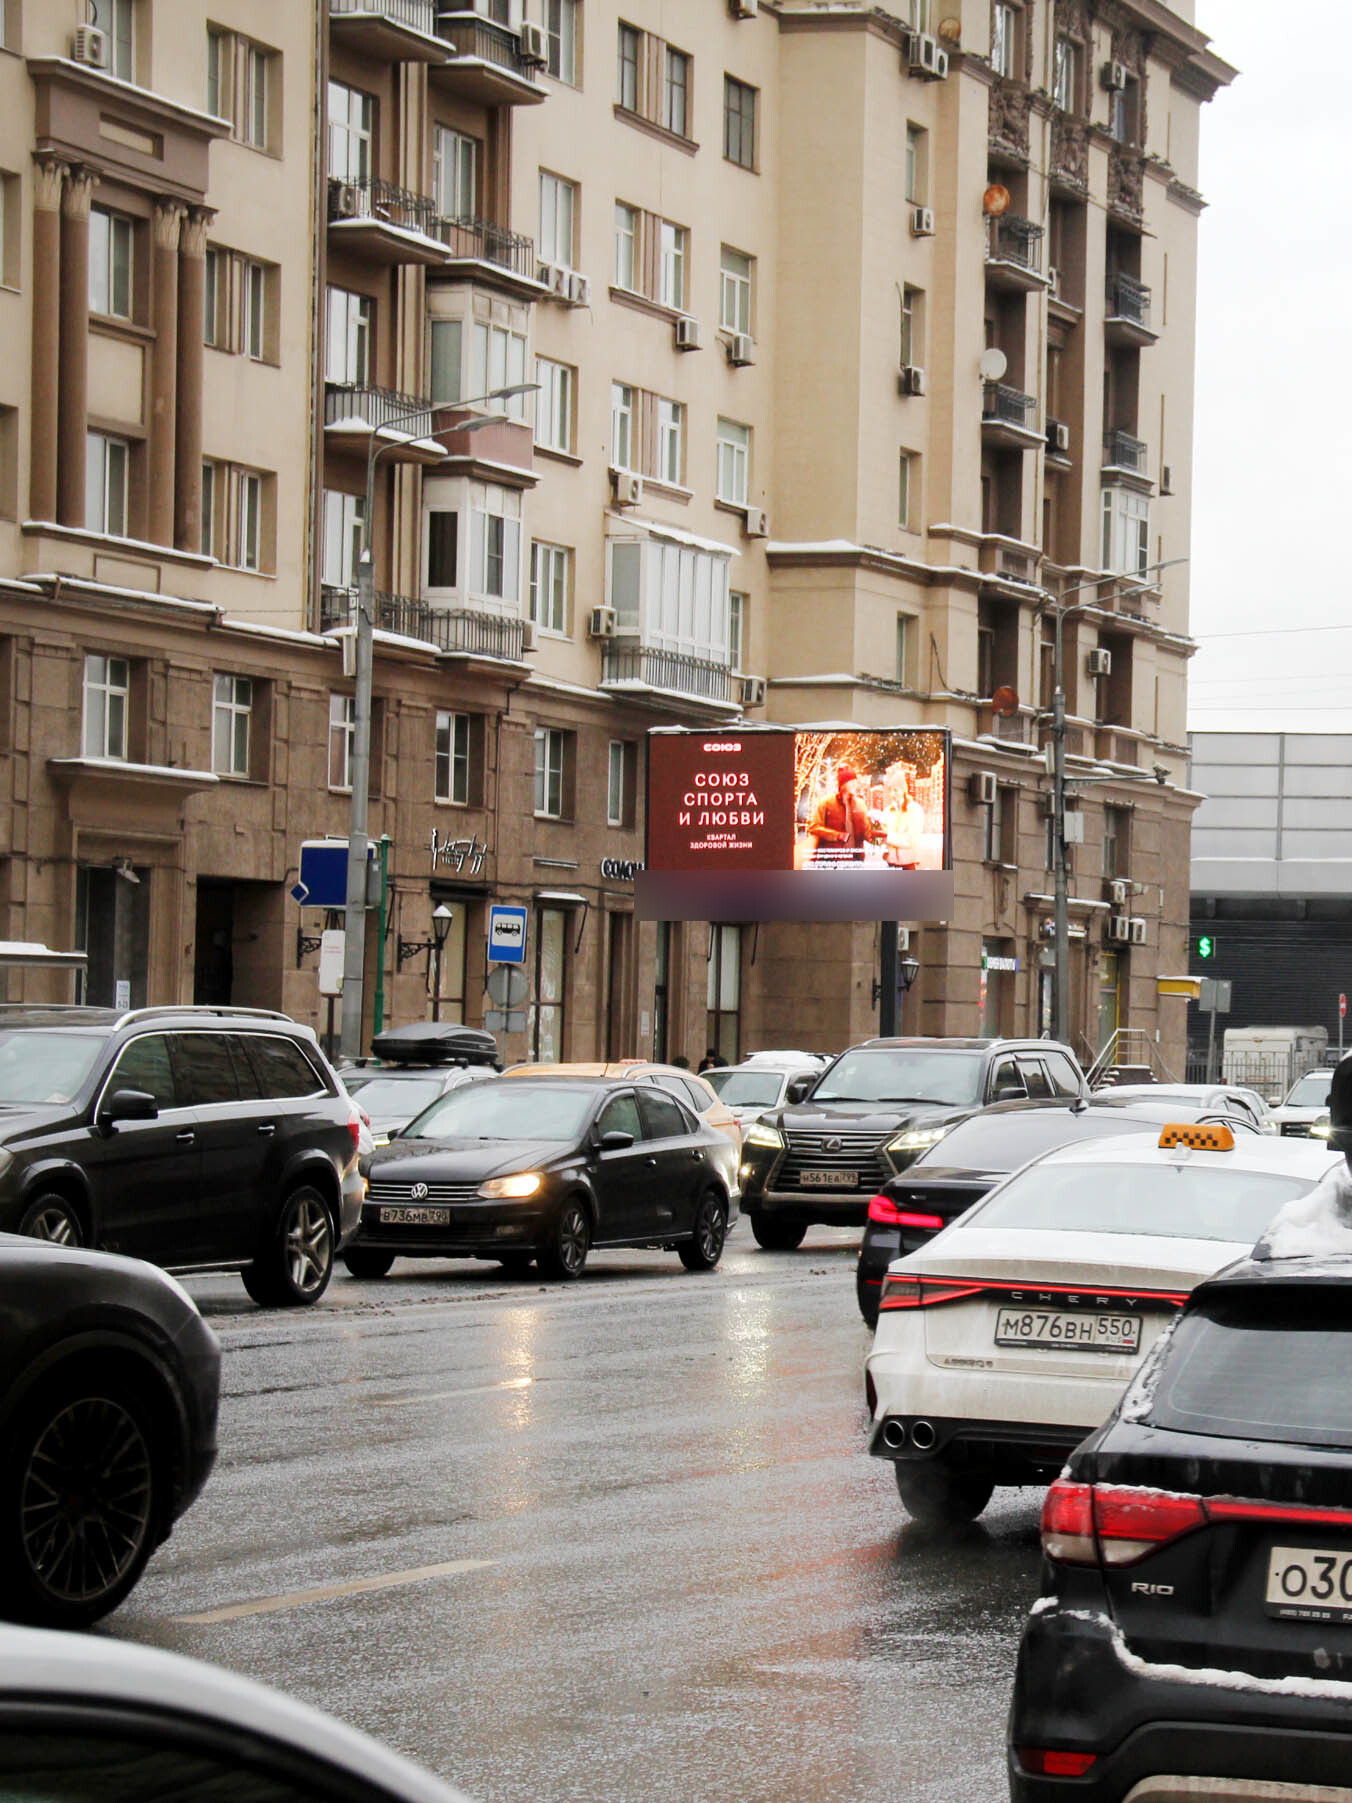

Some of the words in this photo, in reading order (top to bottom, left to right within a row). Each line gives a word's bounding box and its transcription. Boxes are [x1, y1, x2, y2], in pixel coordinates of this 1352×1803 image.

[695, 773, 749, 787] СОЮЗ
[684, 792, 758, 806] СПОРТА
[679, 812, 690, 826] И
[698, 811, 765, 826] ЛЮБВИ
[690, 841, 727, 849] ЗДОРОВОЙ
[728, 841, 753, 849] ЖИЗНИ
[1011, 1291, 1137, 1307] CHERY
[1004, 1314, 1093, 1340] М876ВН
[1098, 1317, 1133, 1337] 550
[1131, 1582, 1174, 1595] RIO
